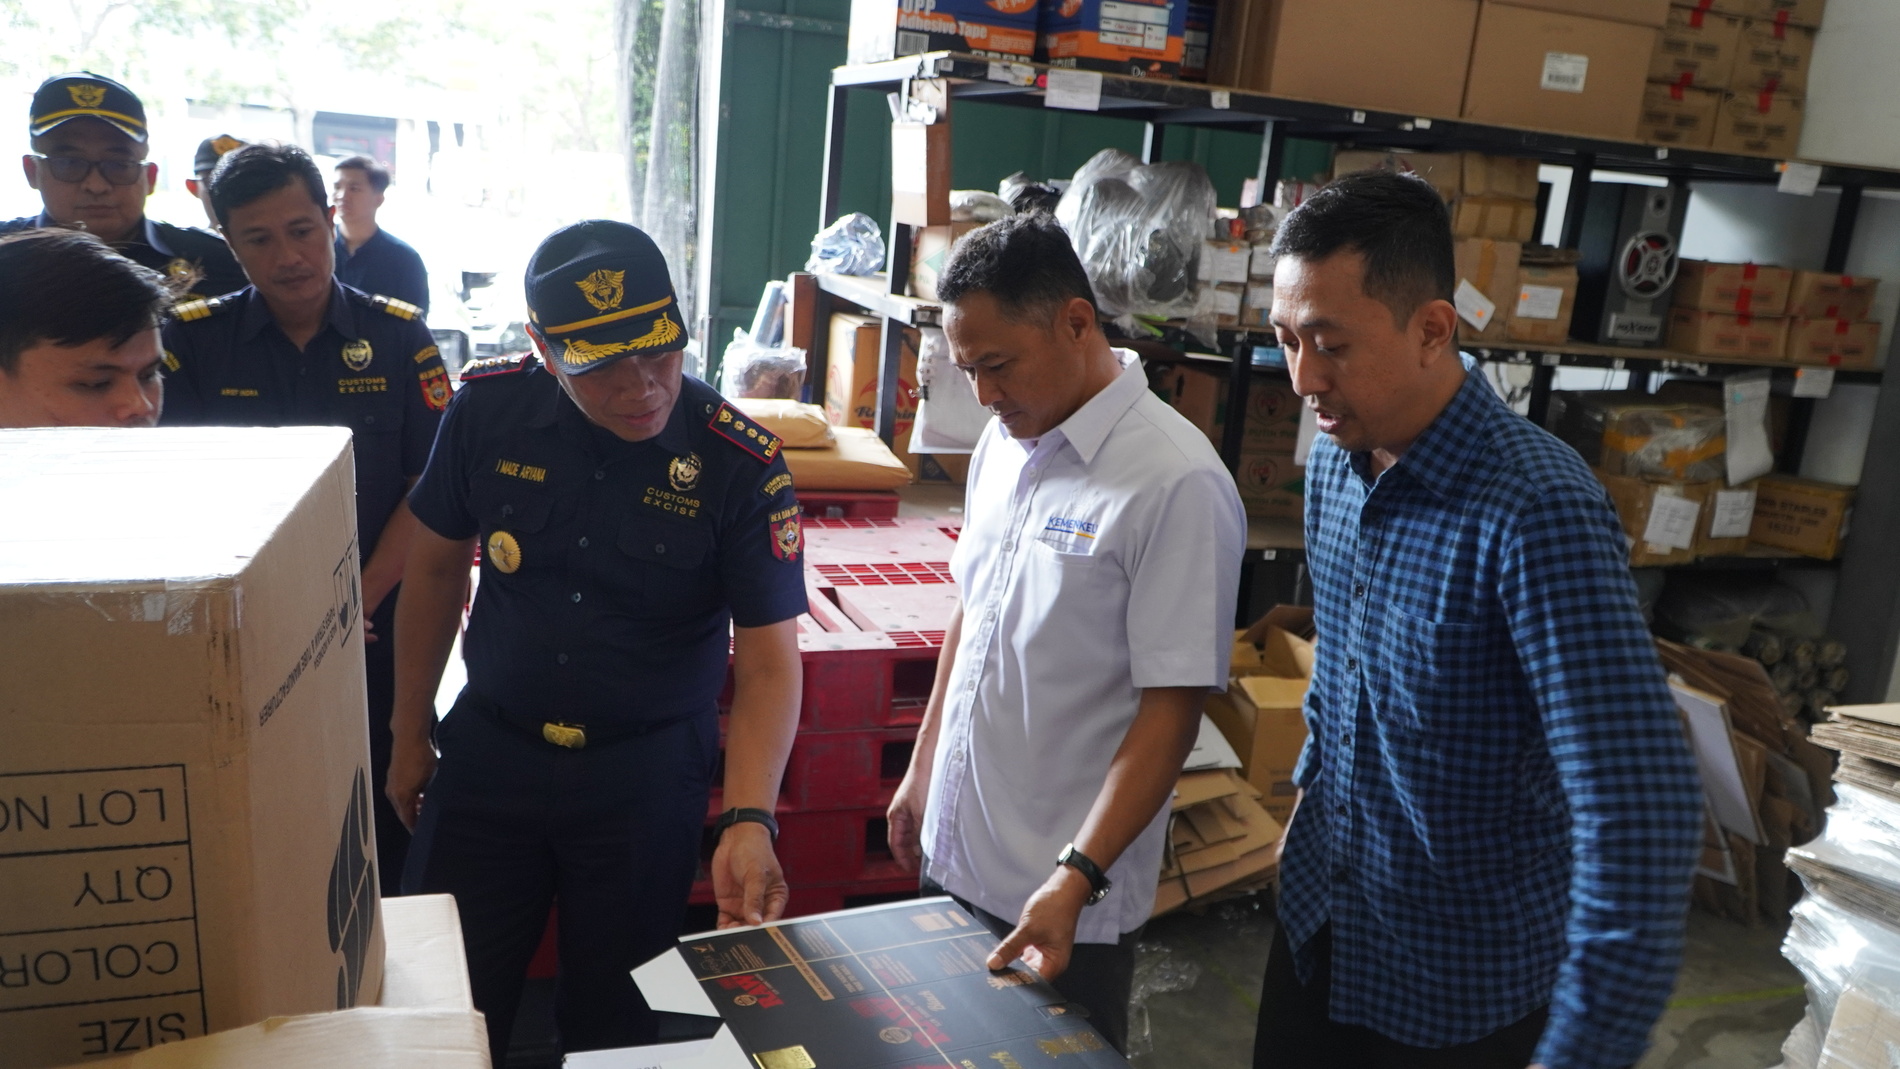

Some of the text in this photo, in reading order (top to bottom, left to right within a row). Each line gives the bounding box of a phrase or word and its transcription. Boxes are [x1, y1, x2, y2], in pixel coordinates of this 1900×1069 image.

[898, 14, 988, 39] Adhesive Tape
[338, 377, 387, 386] CUSTOMS
[339, 385, 388, 394] EXCISE
[500, 460, 520, 477] MADE
[643, 496, 697, 517] EXCISE
[647, 487, 700, 508] CUSTOMS
[1047, 516, 1099, 534] KEMENKEU
[259, 661, 302, 727] MANUFACTURER
[68, 788, 166, 828] LOT
[74, 865, 173, 907] QTY
[0, 941, 179, 988] COLOR
[732, 975, 784, 1009] RAW
[79, 1012, 186, 1056] SIZE
[868, 998, 952, 1048] RAW
